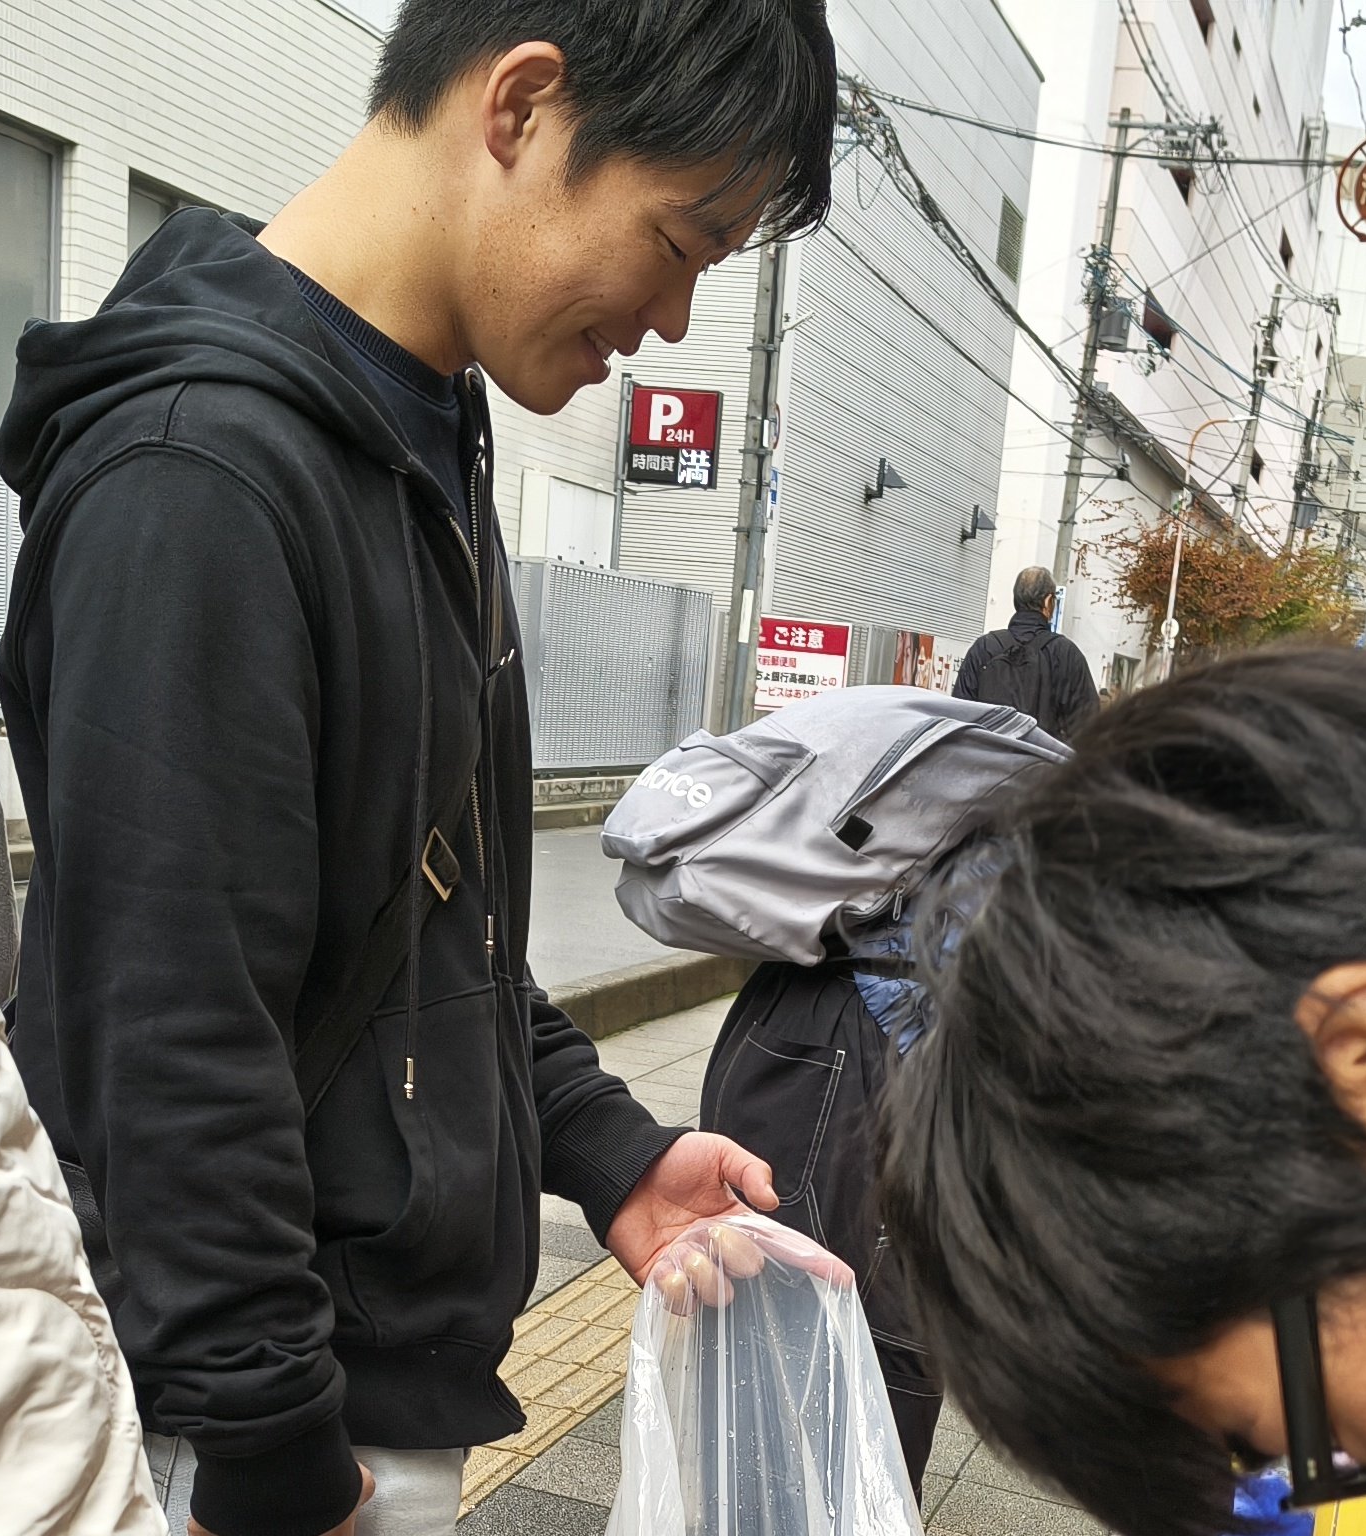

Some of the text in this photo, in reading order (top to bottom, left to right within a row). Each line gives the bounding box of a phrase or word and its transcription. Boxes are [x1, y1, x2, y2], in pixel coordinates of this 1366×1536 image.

[648, 393, 695, 444] P 24H
[632, 448, 711, 485] 時間貸 満
[773, 625, 825, 649] ご注意
